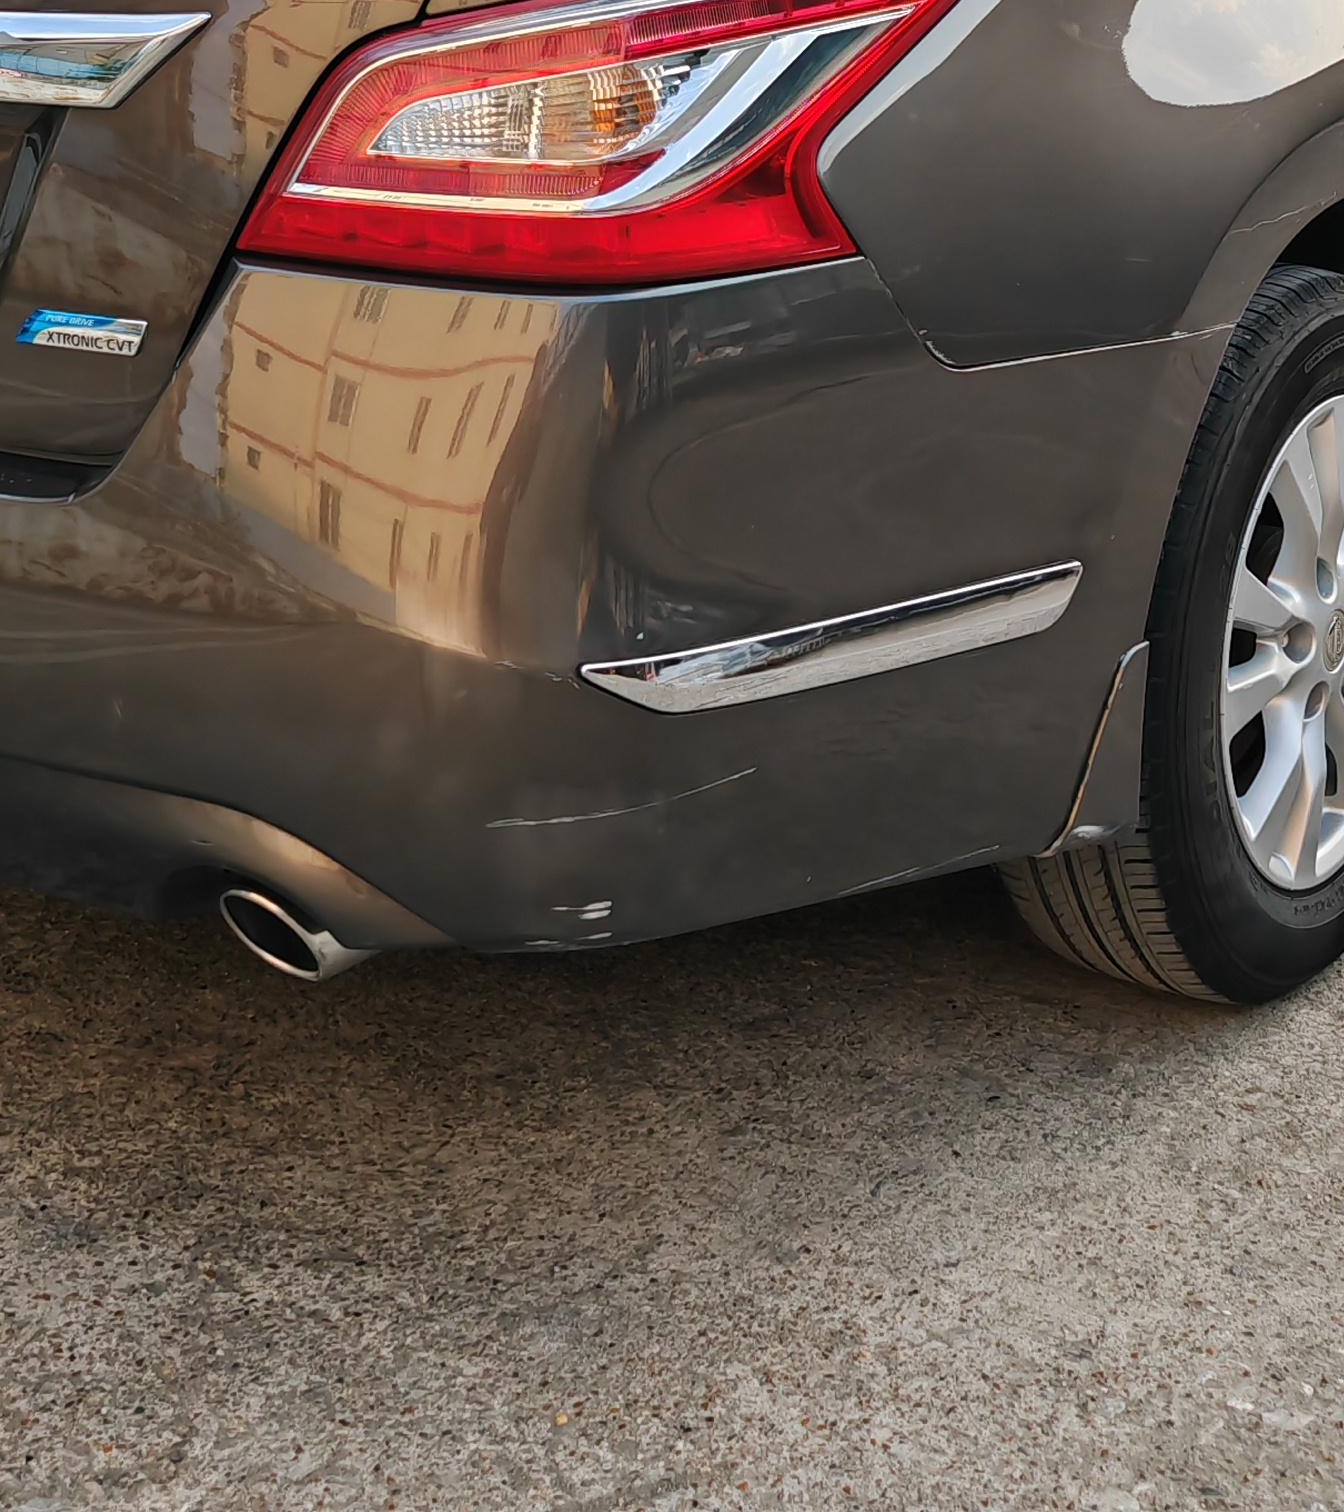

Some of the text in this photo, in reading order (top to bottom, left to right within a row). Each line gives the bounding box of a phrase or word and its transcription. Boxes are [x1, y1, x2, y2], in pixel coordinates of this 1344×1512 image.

[45, 314, 95, 327] PURE DRIVE
[46, 331, 135, 353] XTRONIC CVT
